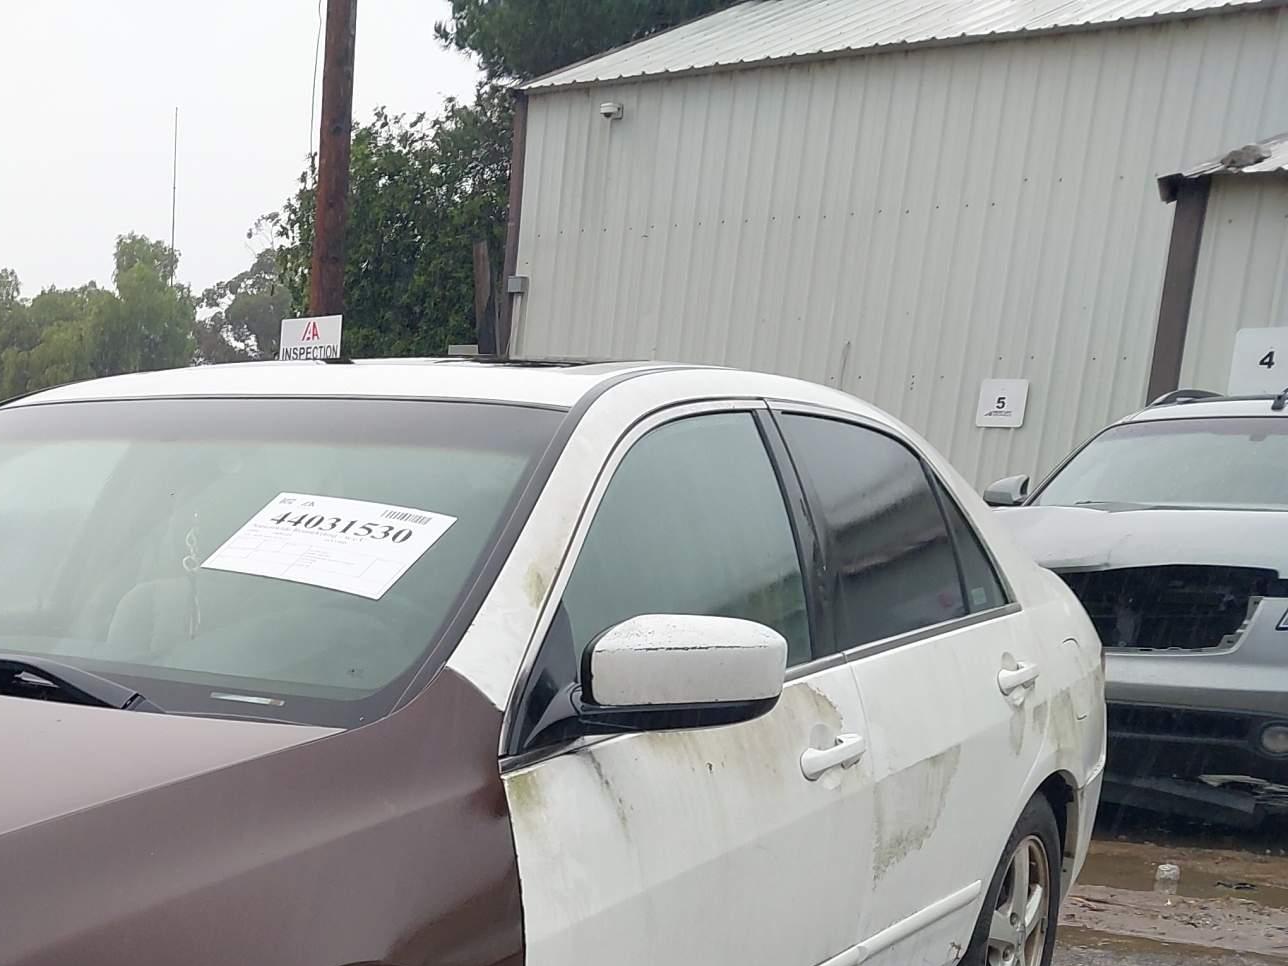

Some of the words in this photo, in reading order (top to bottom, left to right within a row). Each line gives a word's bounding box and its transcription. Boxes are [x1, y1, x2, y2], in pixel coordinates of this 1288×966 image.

[281, 345, 339, 361] INSPECTION
[1258, 351, 1275, 369] 4
[995, 396, 1006, 410] 5
[270, 510, 413, 545] 44031530
